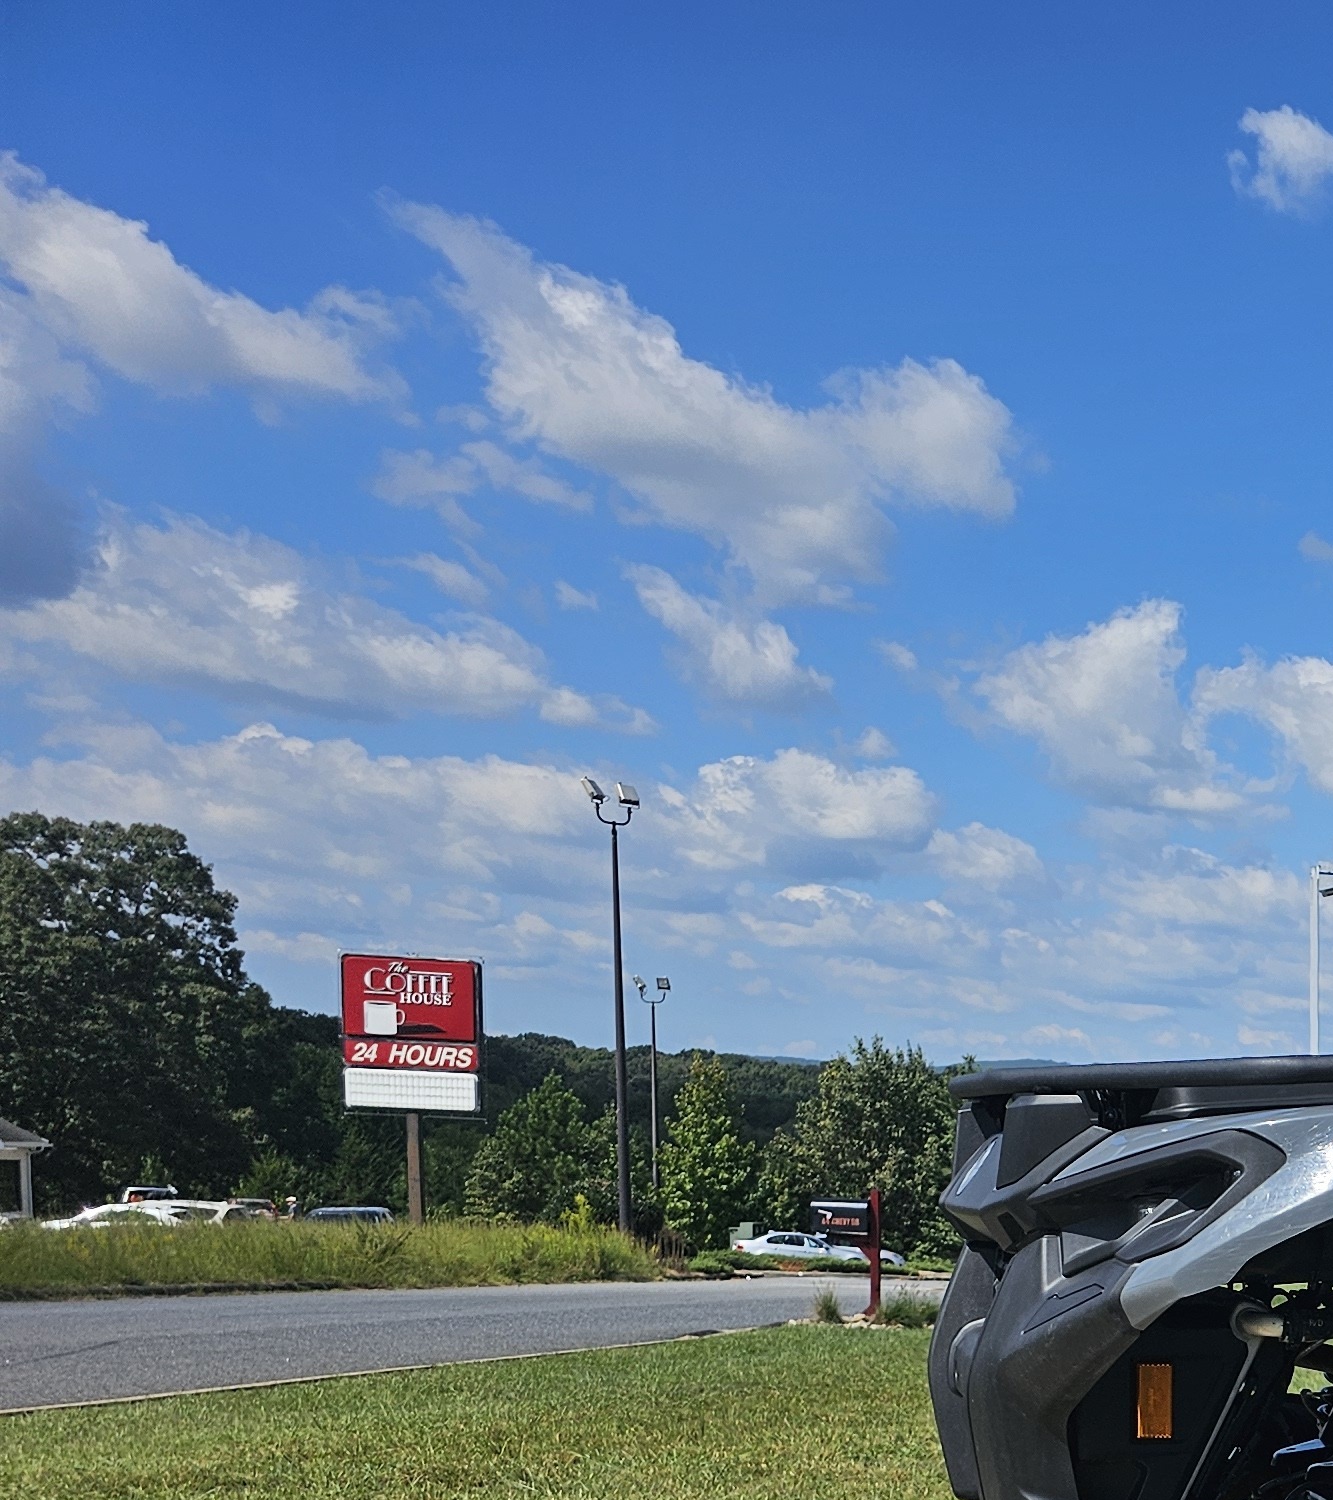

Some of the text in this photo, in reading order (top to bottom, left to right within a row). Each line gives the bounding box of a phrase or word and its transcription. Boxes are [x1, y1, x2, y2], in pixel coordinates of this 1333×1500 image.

[388, 961, 410, 974] The
[399, 991, 453, 1006] HOUSE
[351, 1042, 474, 1069] 24 HOURS
